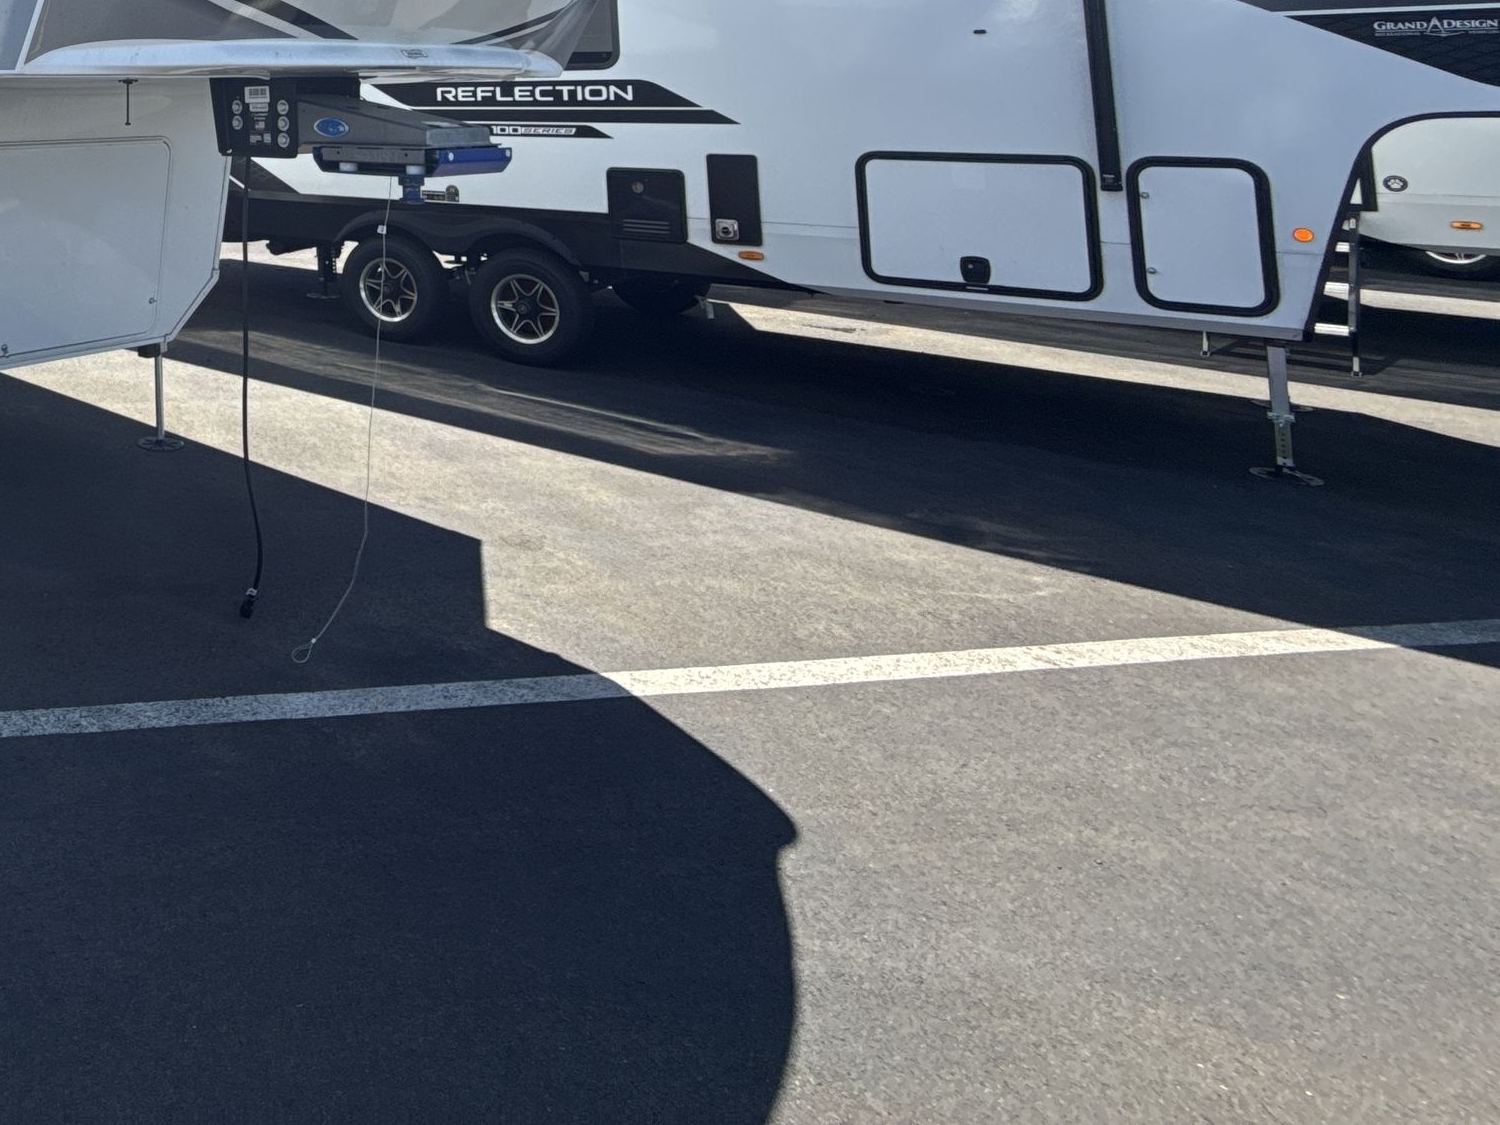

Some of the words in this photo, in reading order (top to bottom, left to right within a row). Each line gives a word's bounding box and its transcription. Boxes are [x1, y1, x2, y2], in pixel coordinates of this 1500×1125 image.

[1373, 21, 1427, 30] GRAND
[1443, 19, 1499, 28] DESIGN
[436, 84, 634, 102] REFLECTION
[491, 125, 521, 135] 100
[522, 126, 575, 136] SERIES
